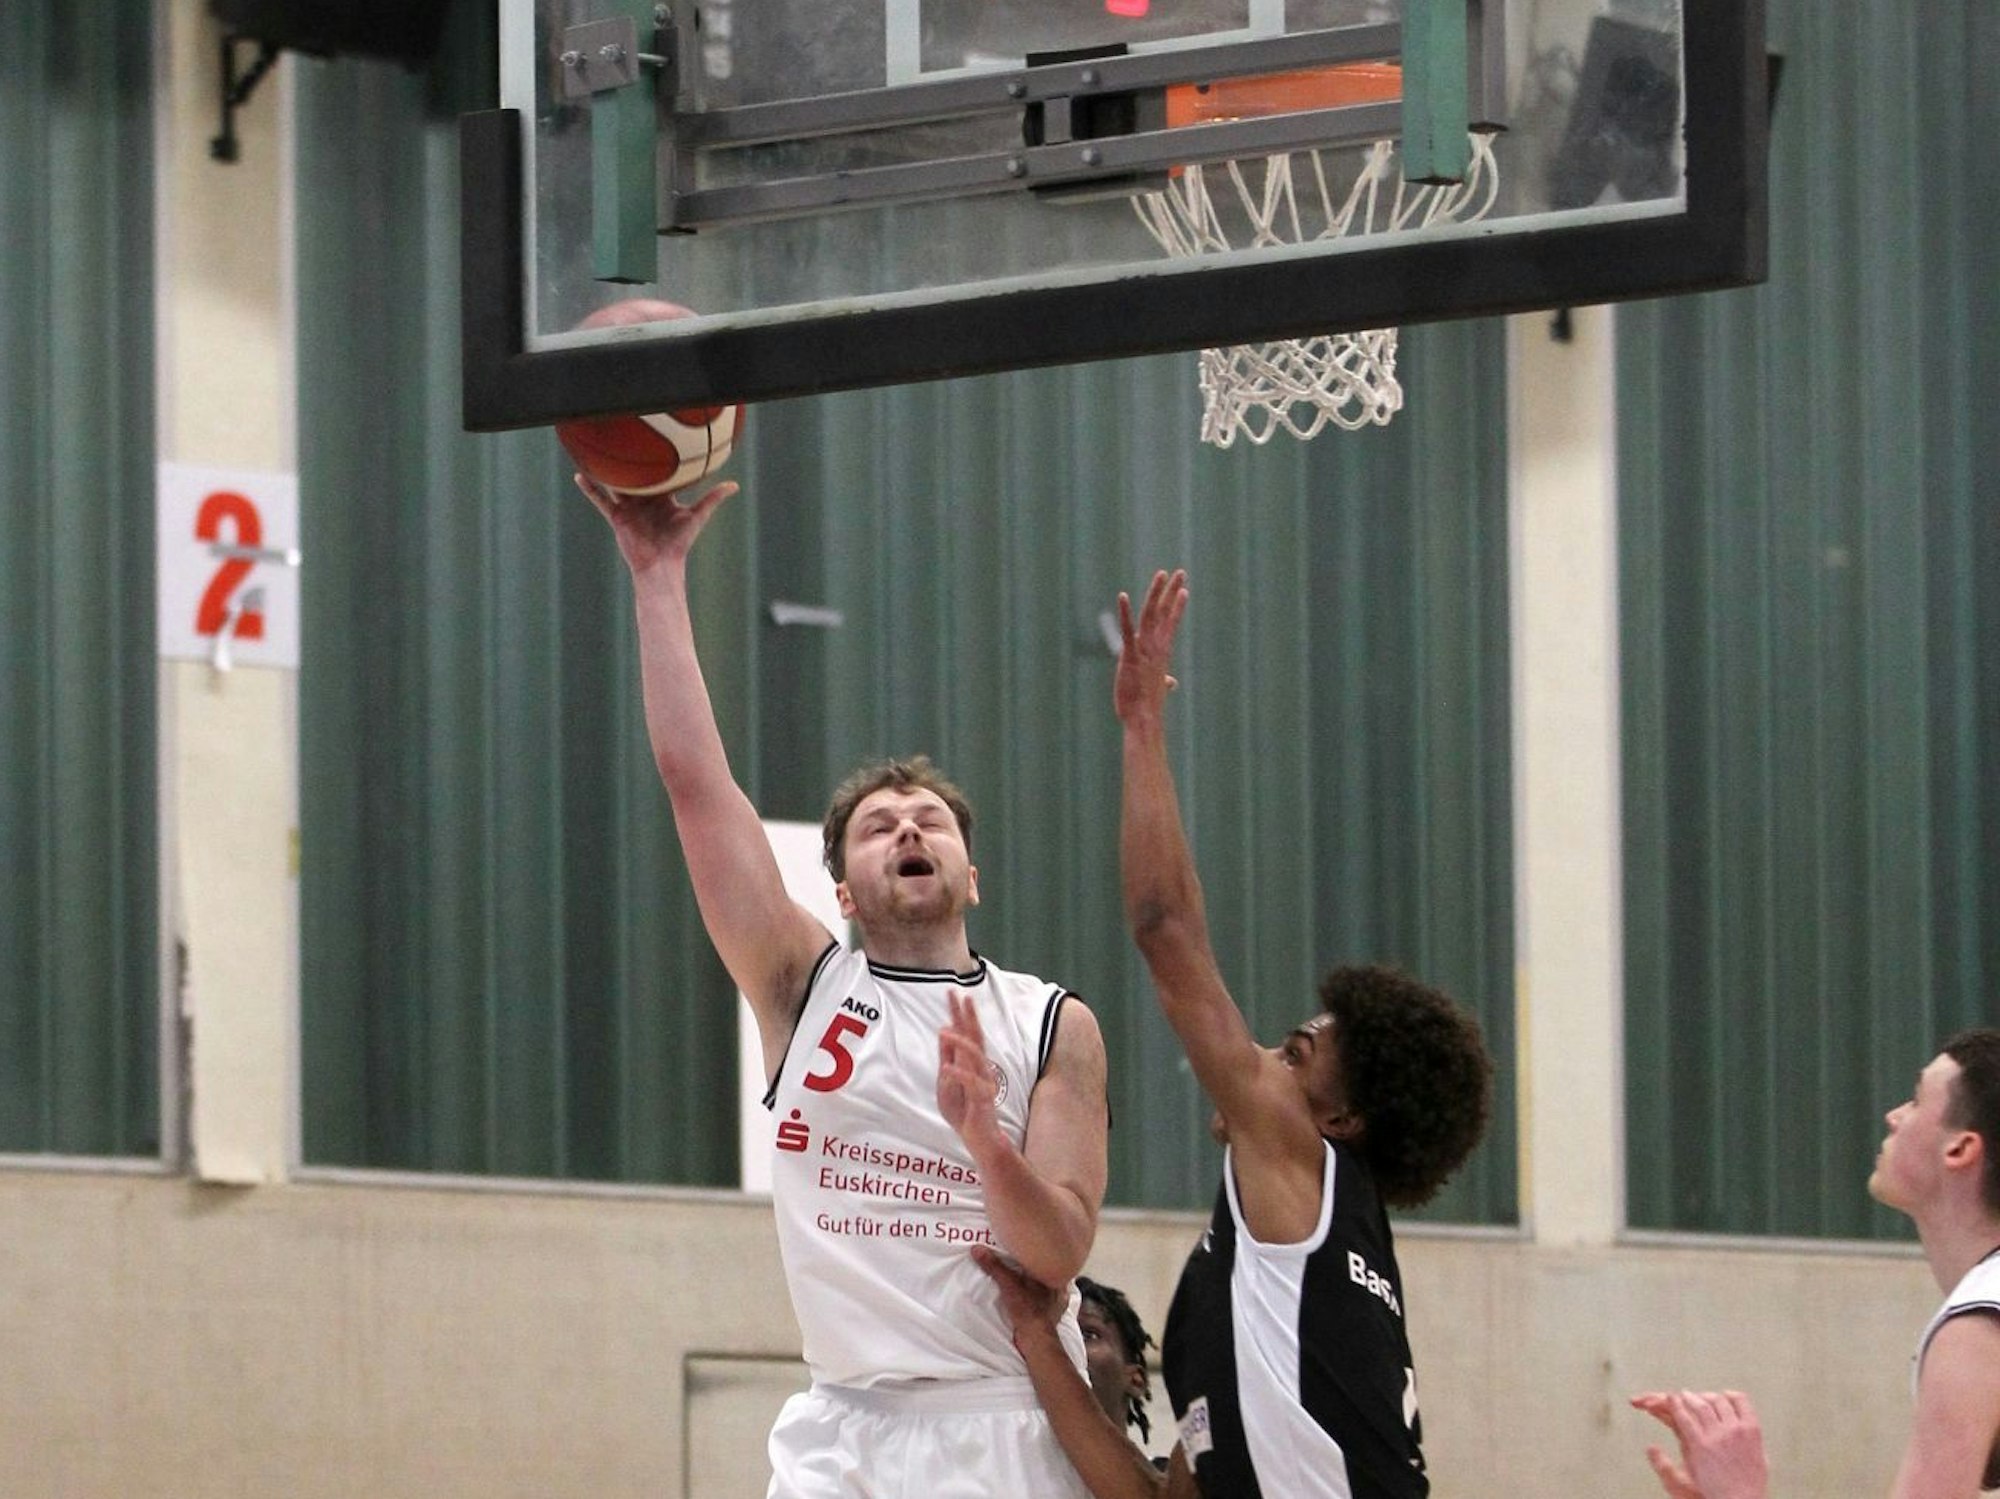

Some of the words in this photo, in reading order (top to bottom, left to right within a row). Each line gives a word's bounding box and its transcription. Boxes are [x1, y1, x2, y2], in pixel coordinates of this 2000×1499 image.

[194, 490, 264, 641] 2
[802, 1012, 868, 1093] 5
[819, 1167, 950, 1205] Euskirchen
[822, 1136, 982, 1186] Kreissparkas
[817, 1214, 850, 1234] Gut
[855, 1216, 883, 1237] für
[889, 1220, 927, 1238] den
[934, 1221, 997, 1245] Sport.
